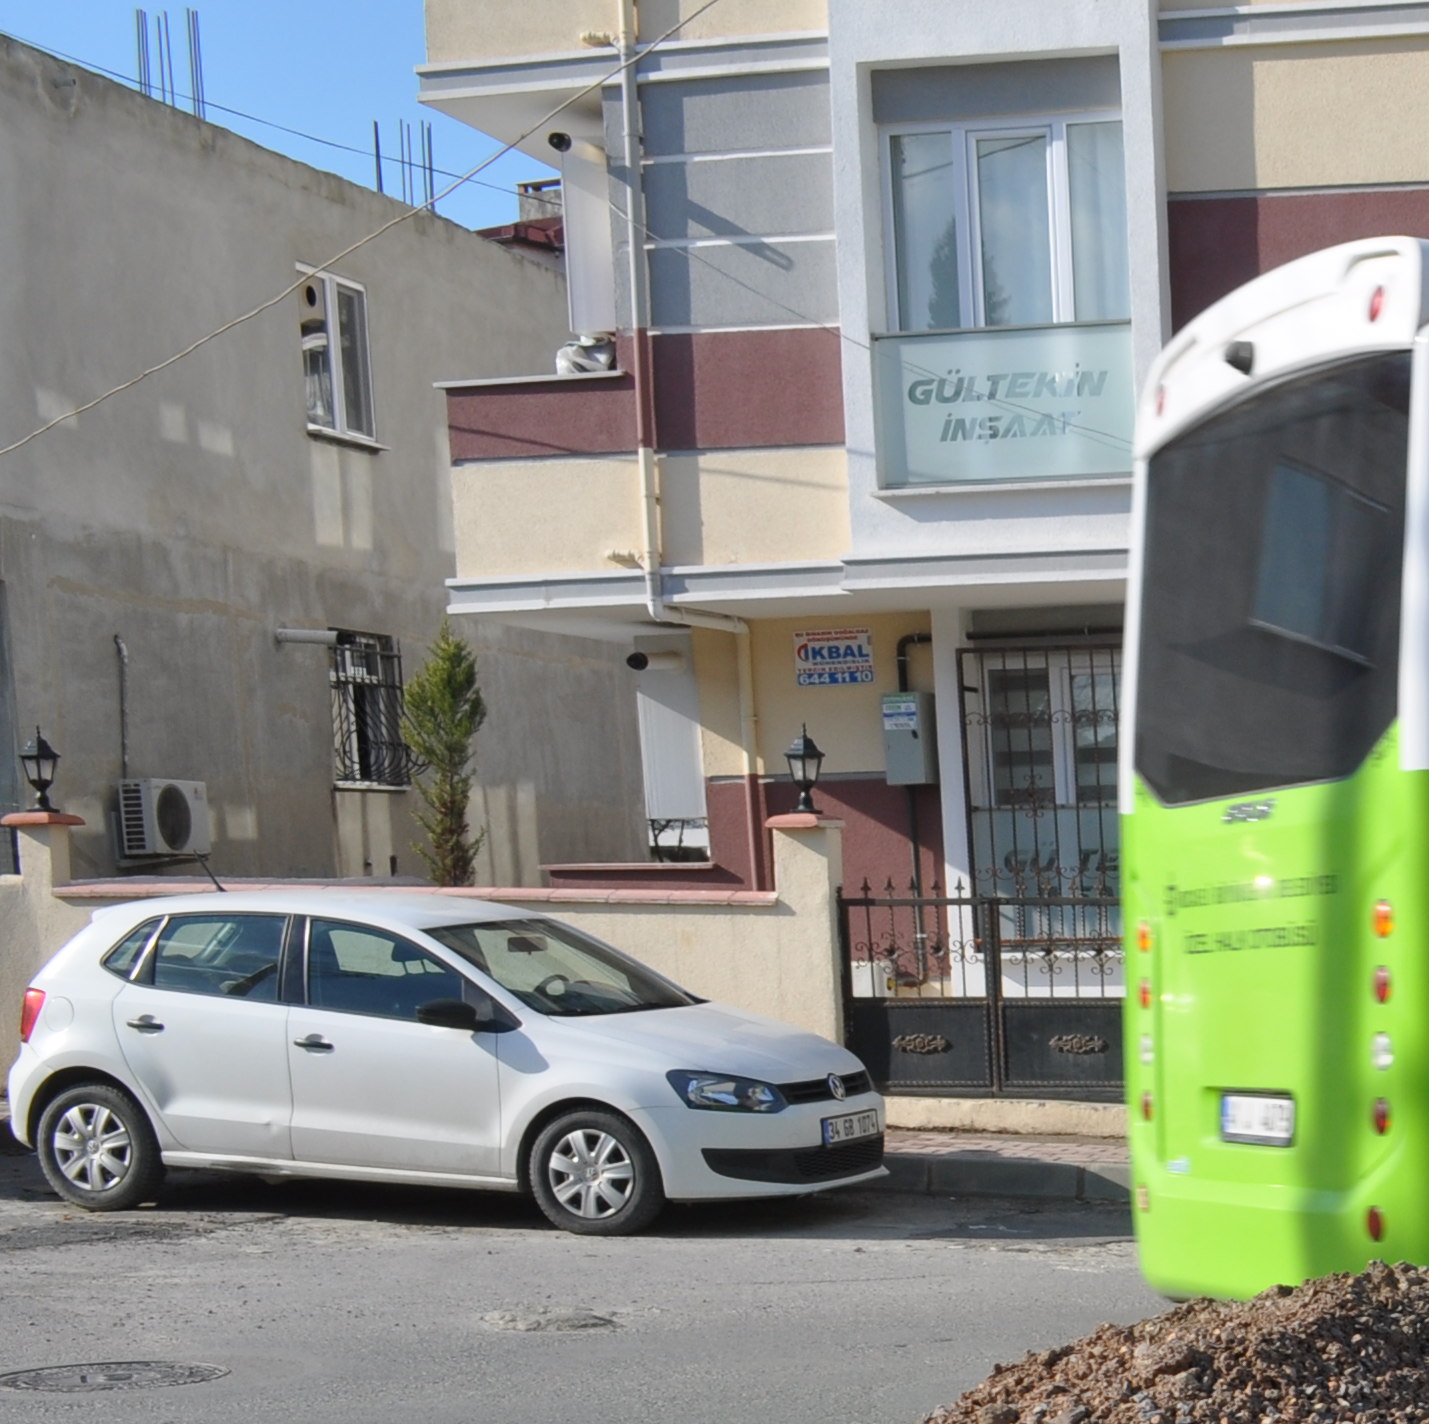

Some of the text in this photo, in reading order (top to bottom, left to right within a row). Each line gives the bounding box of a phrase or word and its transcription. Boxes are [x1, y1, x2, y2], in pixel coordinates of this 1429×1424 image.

[908, 362, 1108, 405] GÜLTEKİN
[939, 410, 1081, 445] İNŞAAT
[799, 672, 829, 685] 644
[854, 671, 873, 683] 10
[828, 1121, 841, 1139] 34
[843, 1118, 855, 1137] GB
